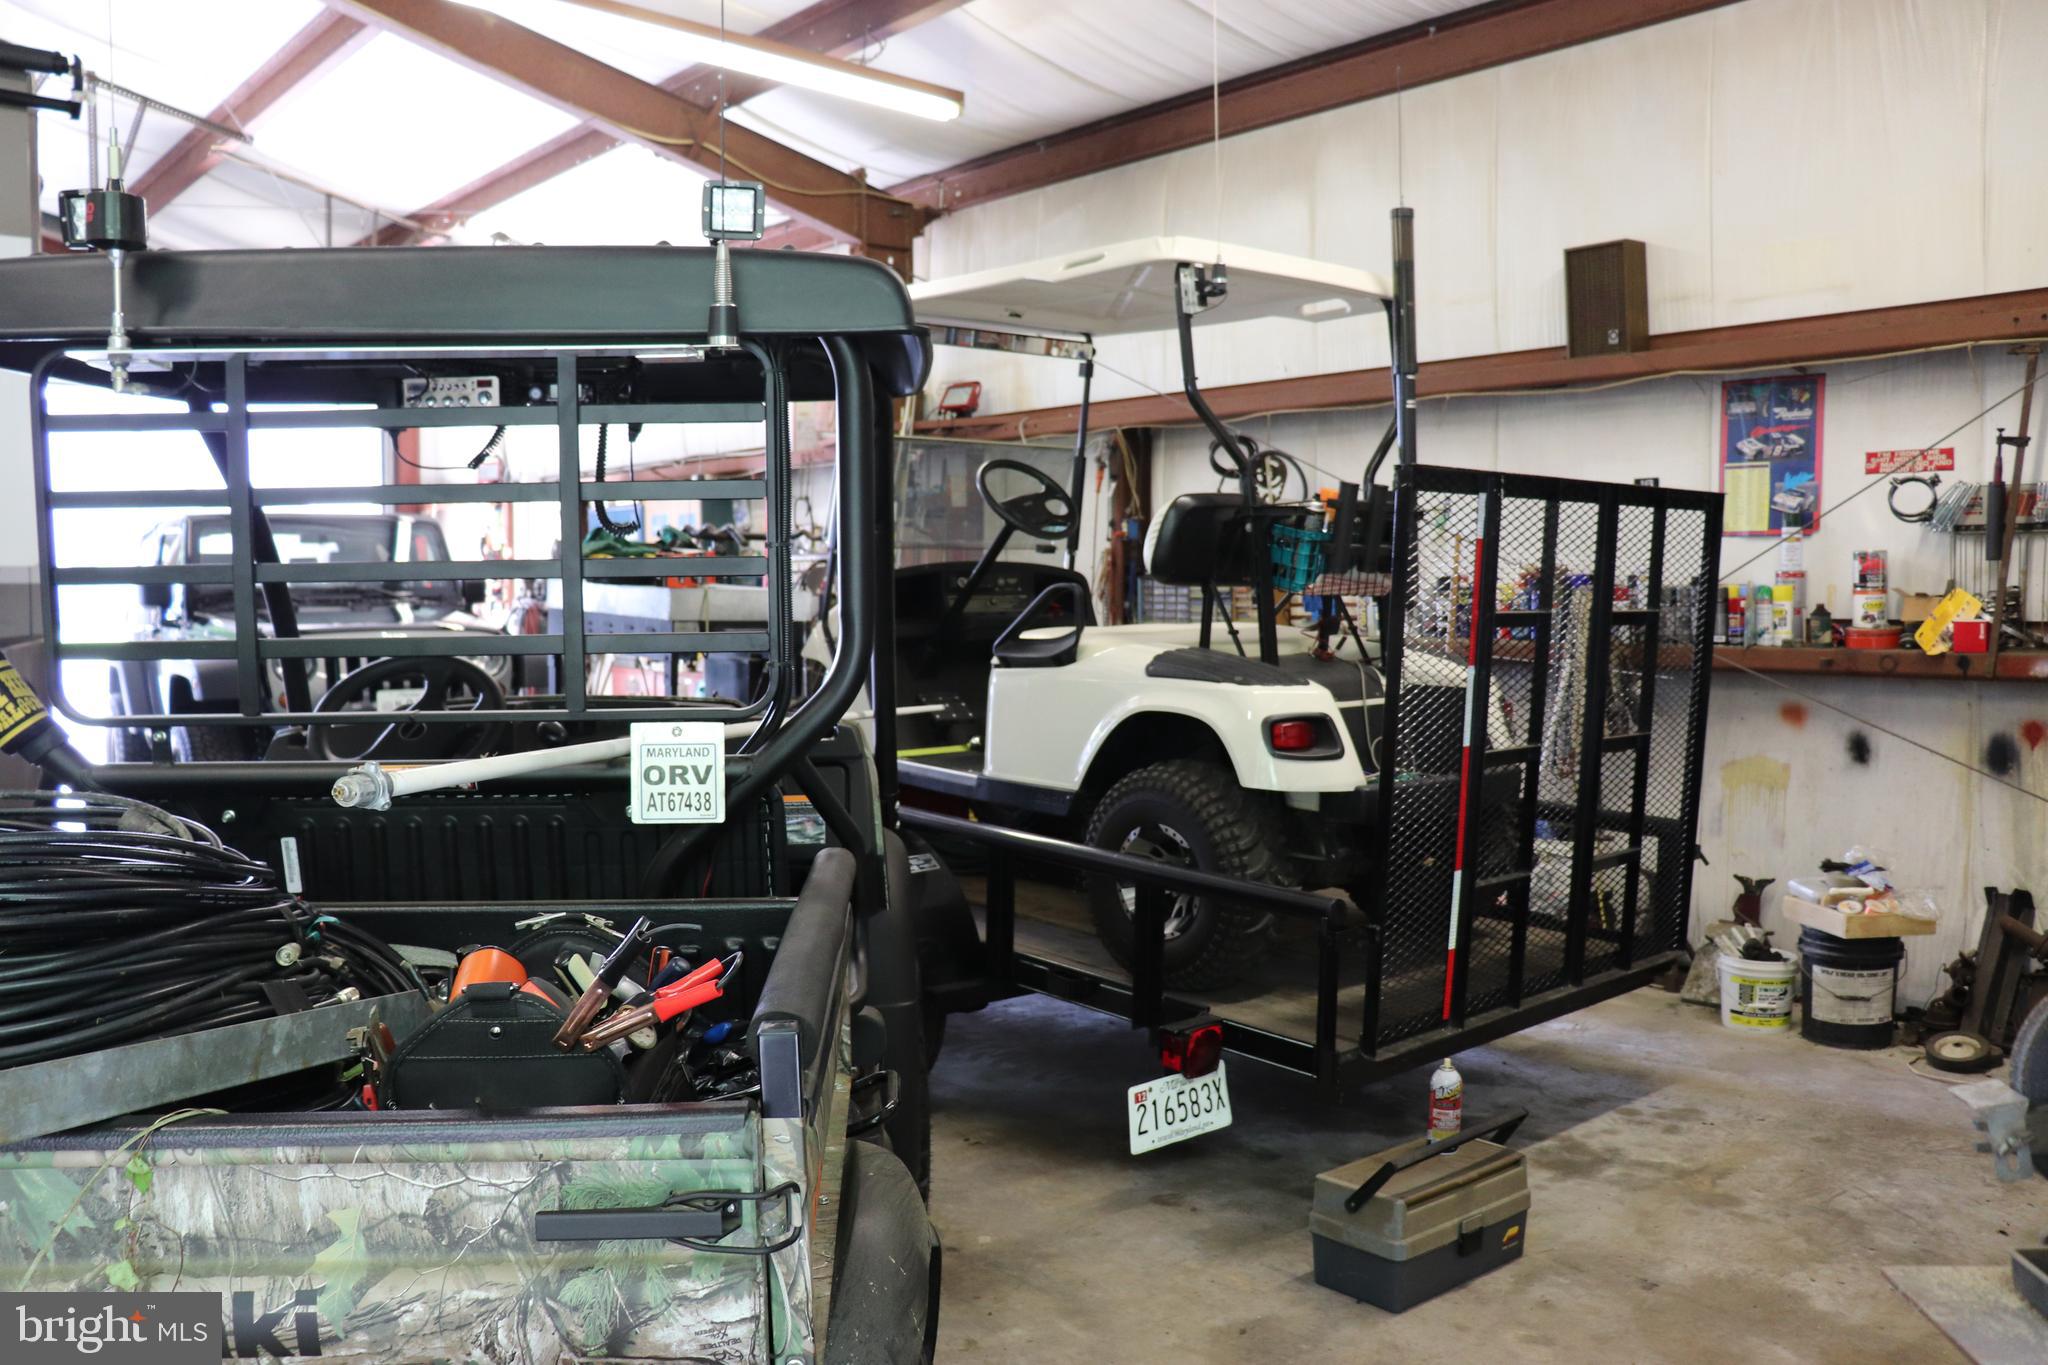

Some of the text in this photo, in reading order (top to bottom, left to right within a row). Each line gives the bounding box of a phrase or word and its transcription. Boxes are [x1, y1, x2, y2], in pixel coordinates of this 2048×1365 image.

[646, 747, 710, 758] MARYLAND
[643, 764, 713, 786] ORV
[646, 791, 712, 812] AT67438
[1137, 1077, 1226, 1136] 216583X
[223, 1290, 322, 1358] ki
